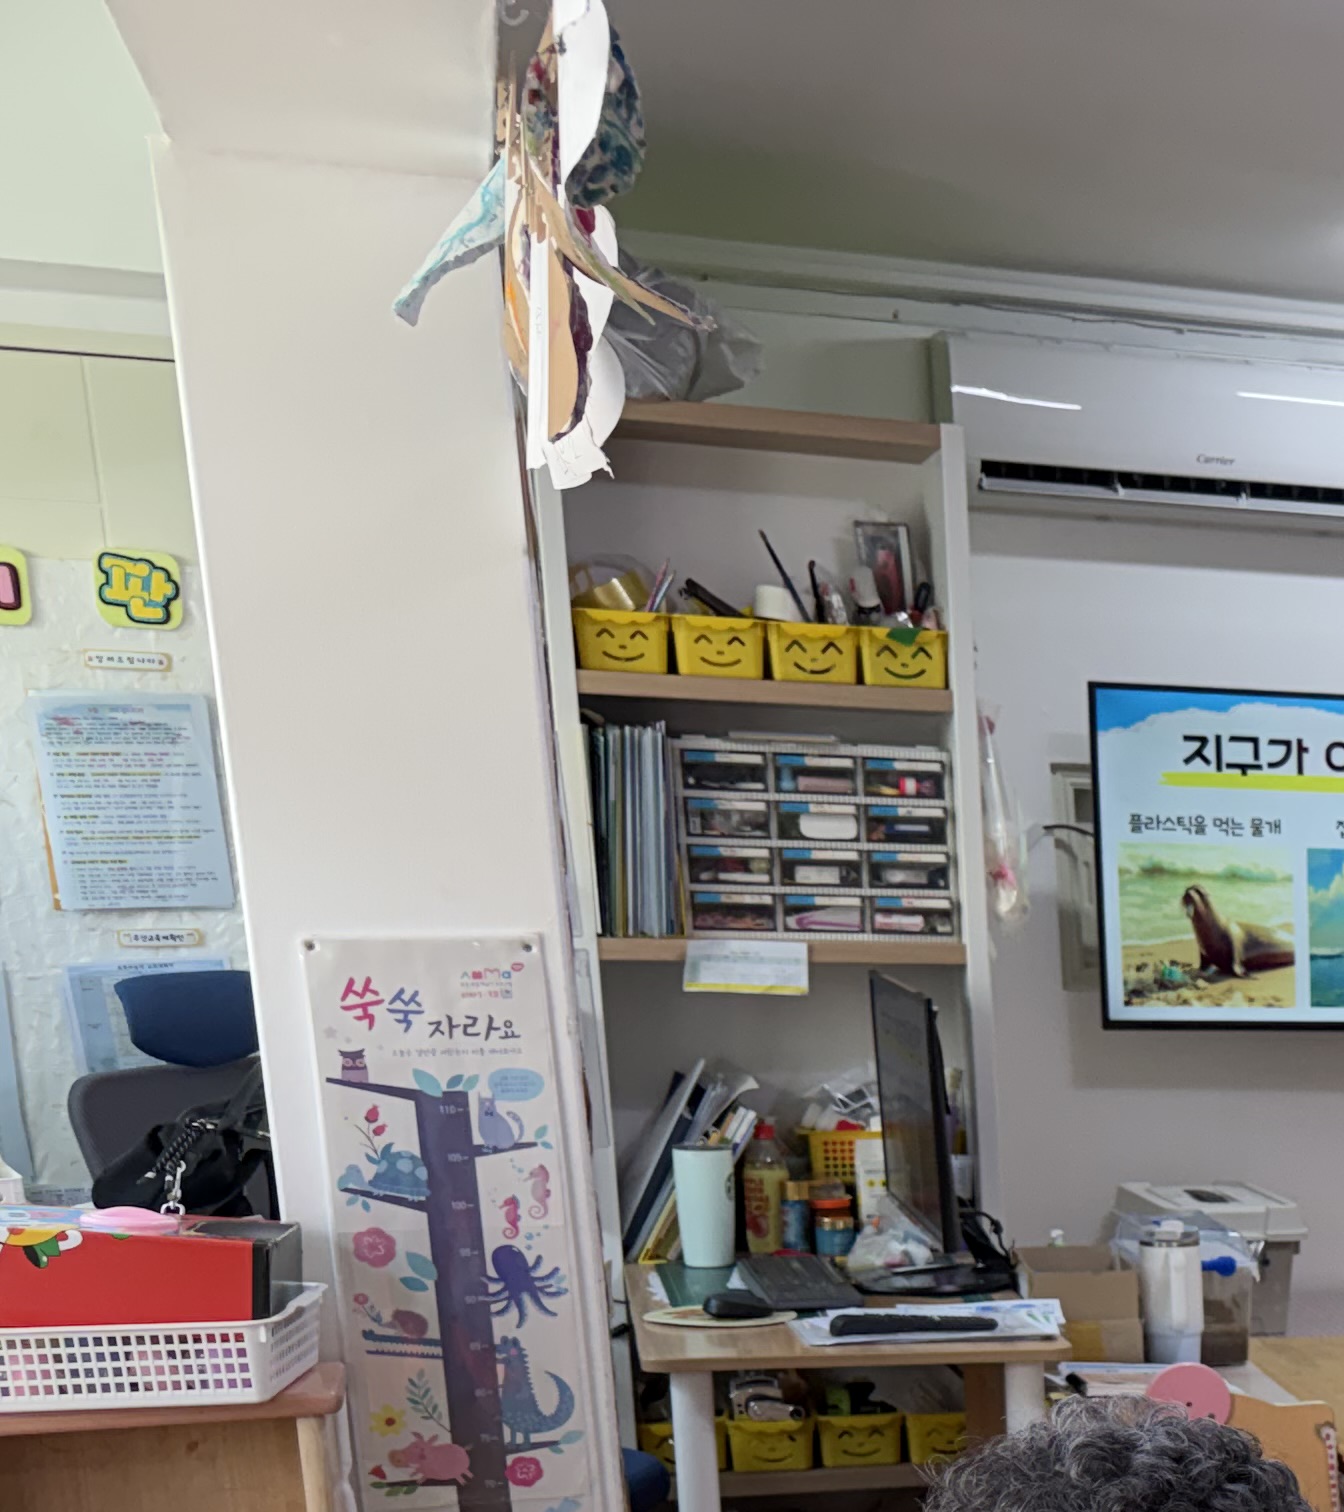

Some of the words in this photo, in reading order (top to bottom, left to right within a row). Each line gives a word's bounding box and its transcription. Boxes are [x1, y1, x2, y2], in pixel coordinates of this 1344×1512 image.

[98, 552, 180, 624] 판
[1182, 734, 1309, 777] 지구가
[1128, 813, 1208, 836] 플라스틱을
[1212, 817, 1245, 837] 먹는
[1250, 818, 1281, 837] 물개
[340, 976, 385, 1031] 쑥
[386, 986, 425, 1033] 쑥
[428, 1014, 521, 1041] 자라요
